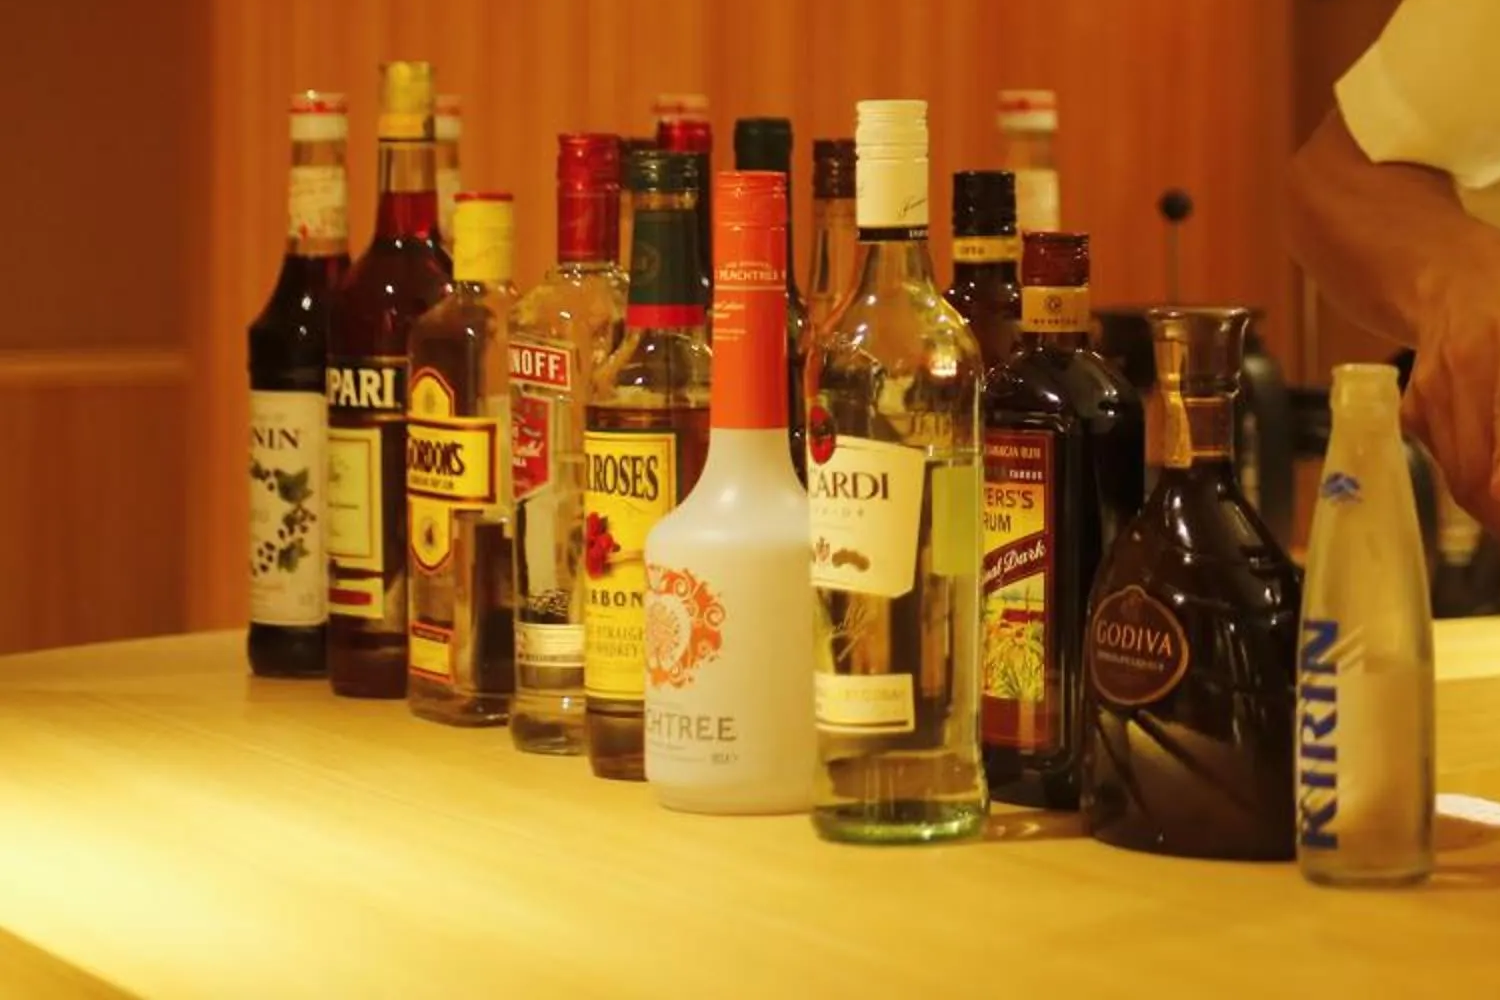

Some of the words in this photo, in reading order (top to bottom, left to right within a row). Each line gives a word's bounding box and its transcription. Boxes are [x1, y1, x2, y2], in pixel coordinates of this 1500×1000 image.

[326, 367, 397, 408] PARI
[593, 454, 659, 502] ROSES
[984, 486, 1035, 511] ERS'S
[1003, 538, 1046, 574] Dark
[1097, 621, 1172, 657] GODIVA
[1301, 619, 1339, 850] KIRIN
